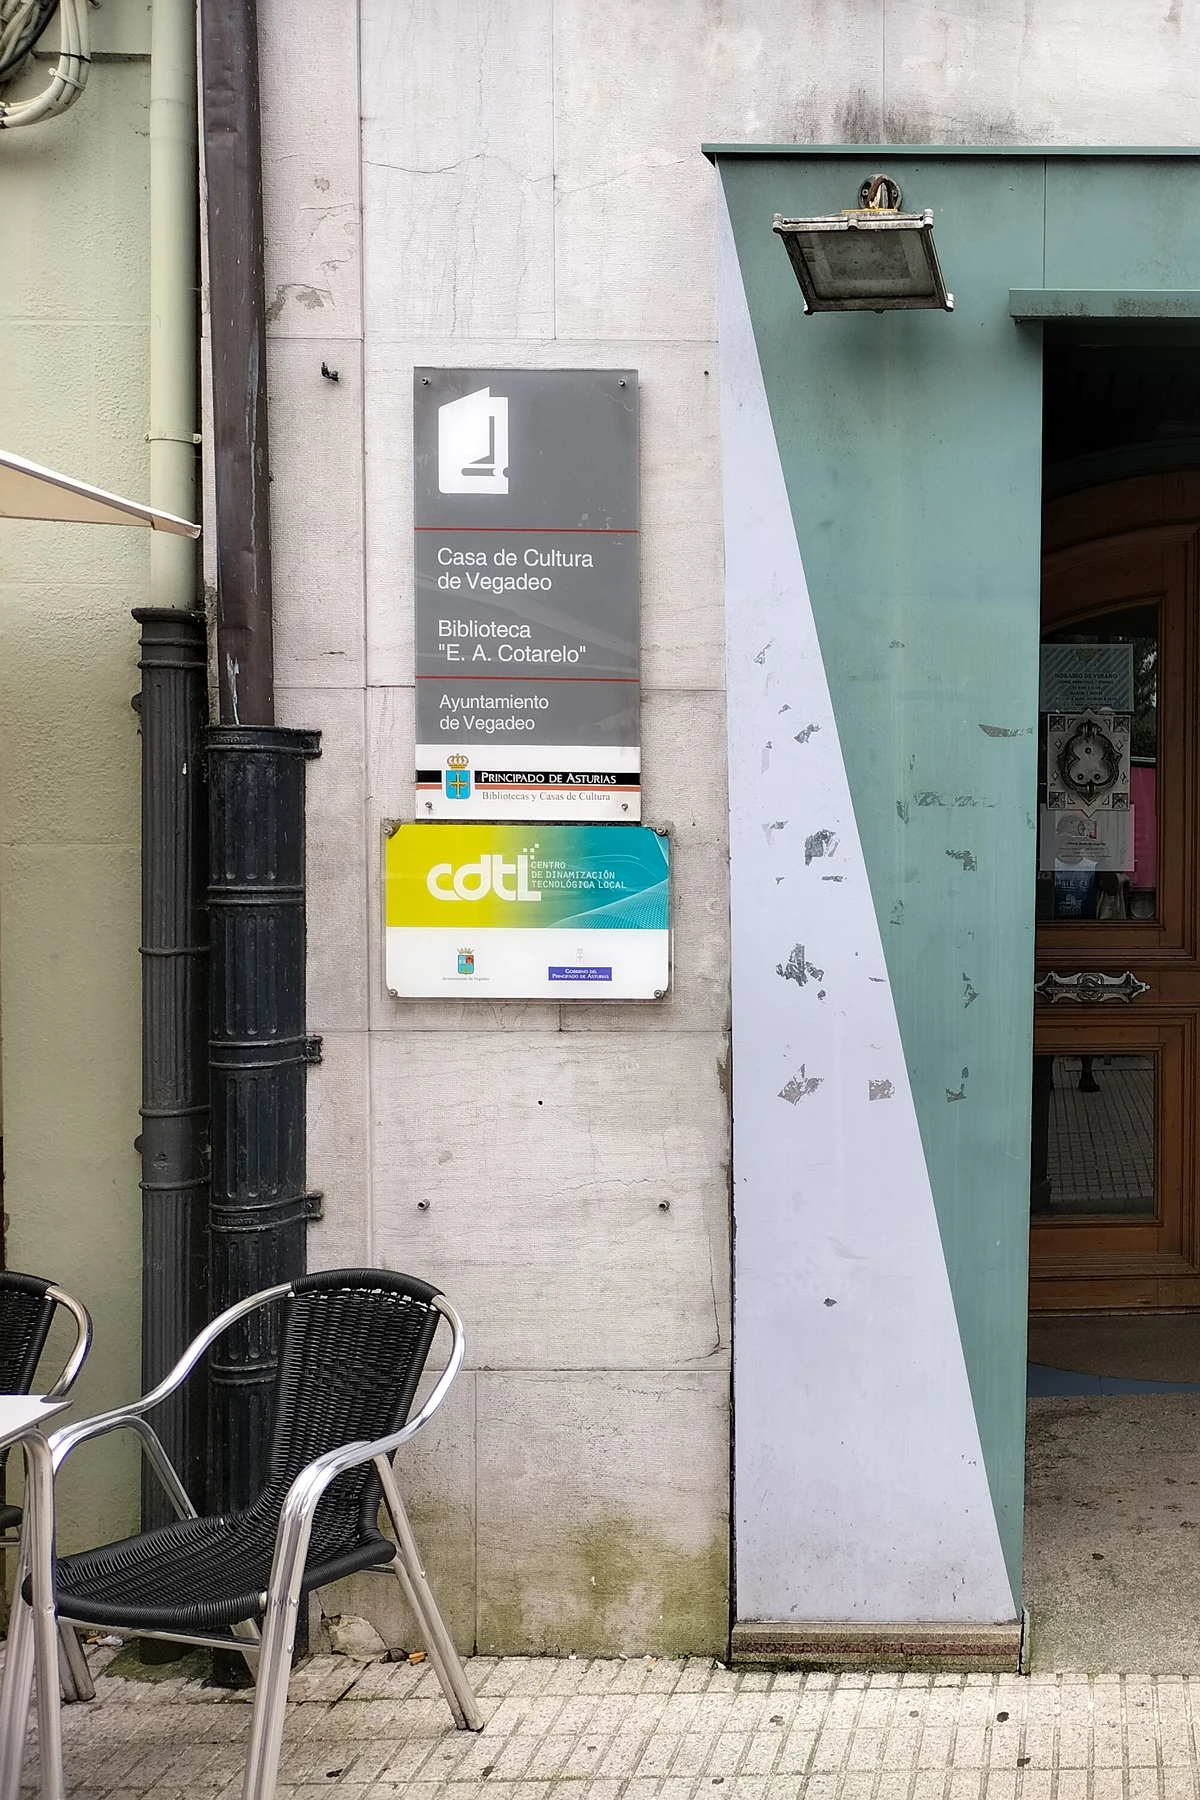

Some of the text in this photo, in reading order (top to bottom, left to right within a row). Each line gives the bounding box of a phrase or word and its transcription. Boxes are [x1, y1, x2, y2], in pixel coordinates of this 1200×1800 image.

[437, 547, 594, 568] Casa de Cultura
[437, 572, 552, 594] de Vegadeo
[438, 620, 531, 638] Biblioteca
[438, 644, 586, 663] "E. A. Cotarelo"
[439, 694, 549, 713] Ayuntamiento
[439, 716, 535, 734] de Vegadeo
[481, 772, 617, 785] PRINCIPADO DE ASTURIAS
[482, 791, 611, 802] Bibliotecas y Casas de Cultura
[531, 861, 566, 869] CENTRO
[531, 870, 615, 880] DE DINAMIZACIÓN
[531, 879, 627, 889] TECNOLÓGICA LOCAL
